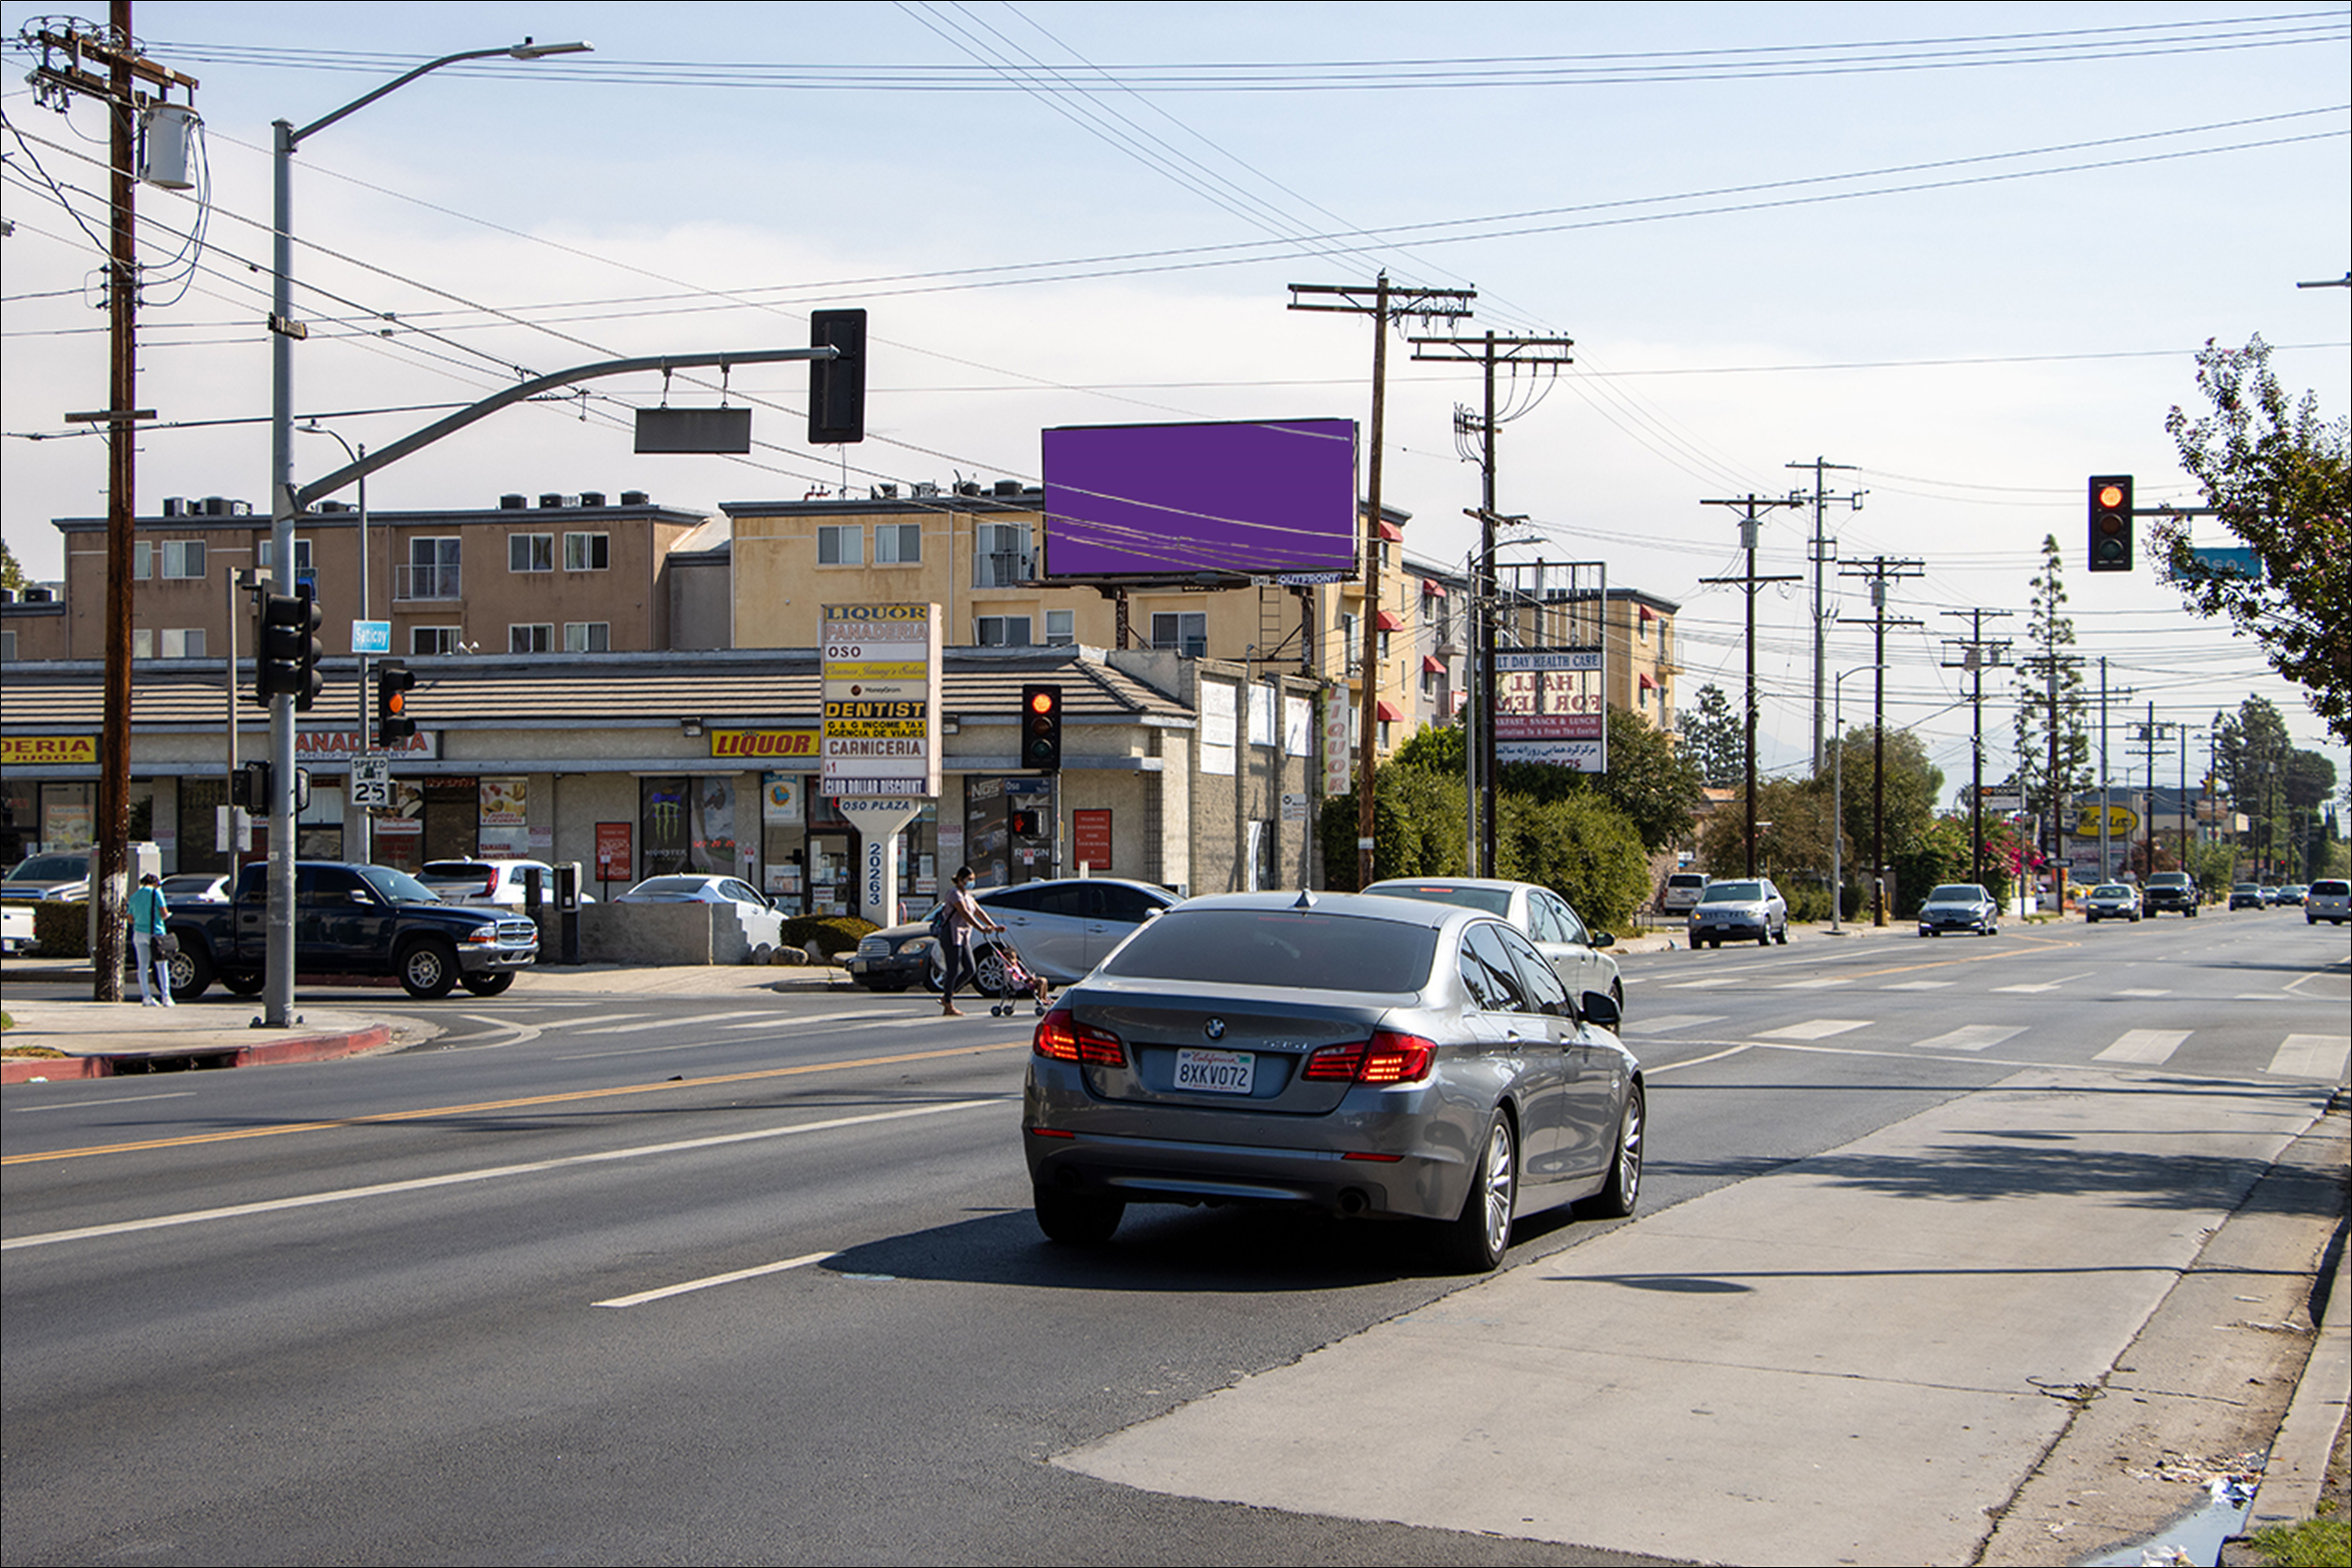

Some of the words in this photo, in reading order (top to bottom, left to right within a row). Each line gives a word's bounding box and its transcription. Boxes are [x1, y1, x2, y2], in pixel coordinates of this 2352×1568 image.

[1277, 572, 1342, 585] OUTFRONT
[826, 607, 927, 621] LIQUOR
[825, 622, 927, 640] PANADERIA
[828, 646, 861, 659] OSO
[1511, 656, 1530, 667] DAY
[1533, 656, 1570, 667] HEALTH
[1573, 655, 1598, 666] CARE
[865, 686, 902, 695] MoneyGram
[825, 702, 925, 717] DENTIST
[1495, 717, 1527, 726] AKFAST,
[1569, 716, 1597, 725] LUNCH
[716, 735, 811, 757] LIQUOR
[1327, 687, 1346, 792] LIQUOR
[1, 740, 92, 754] DERIA
[829, 740, 922, 756] CARNICERIA
[354, 760, 387, 769] SPEED
[355, 782, 386, 802] 25
[825, 779, 847, 794] CLUB
[849, 779, 878, 794] DOLLAR
[880, 779, 923, 794] DISCOUNT
[971, 780, 1001, 799] NOS
[1005, 781, 1021, 791] Oso
[843, 801, 867, 811] OSO
[871, 801, 909, 811] PLAZA
[645, 848, 688, 857] MONSTER
[1014, 848, 1050, 858] RGN
[868, 842, 882, 906] 20263
[1192, 1052, 1240, 1065] California
[1179, 1063, 1249, 1088] 8XKV072
